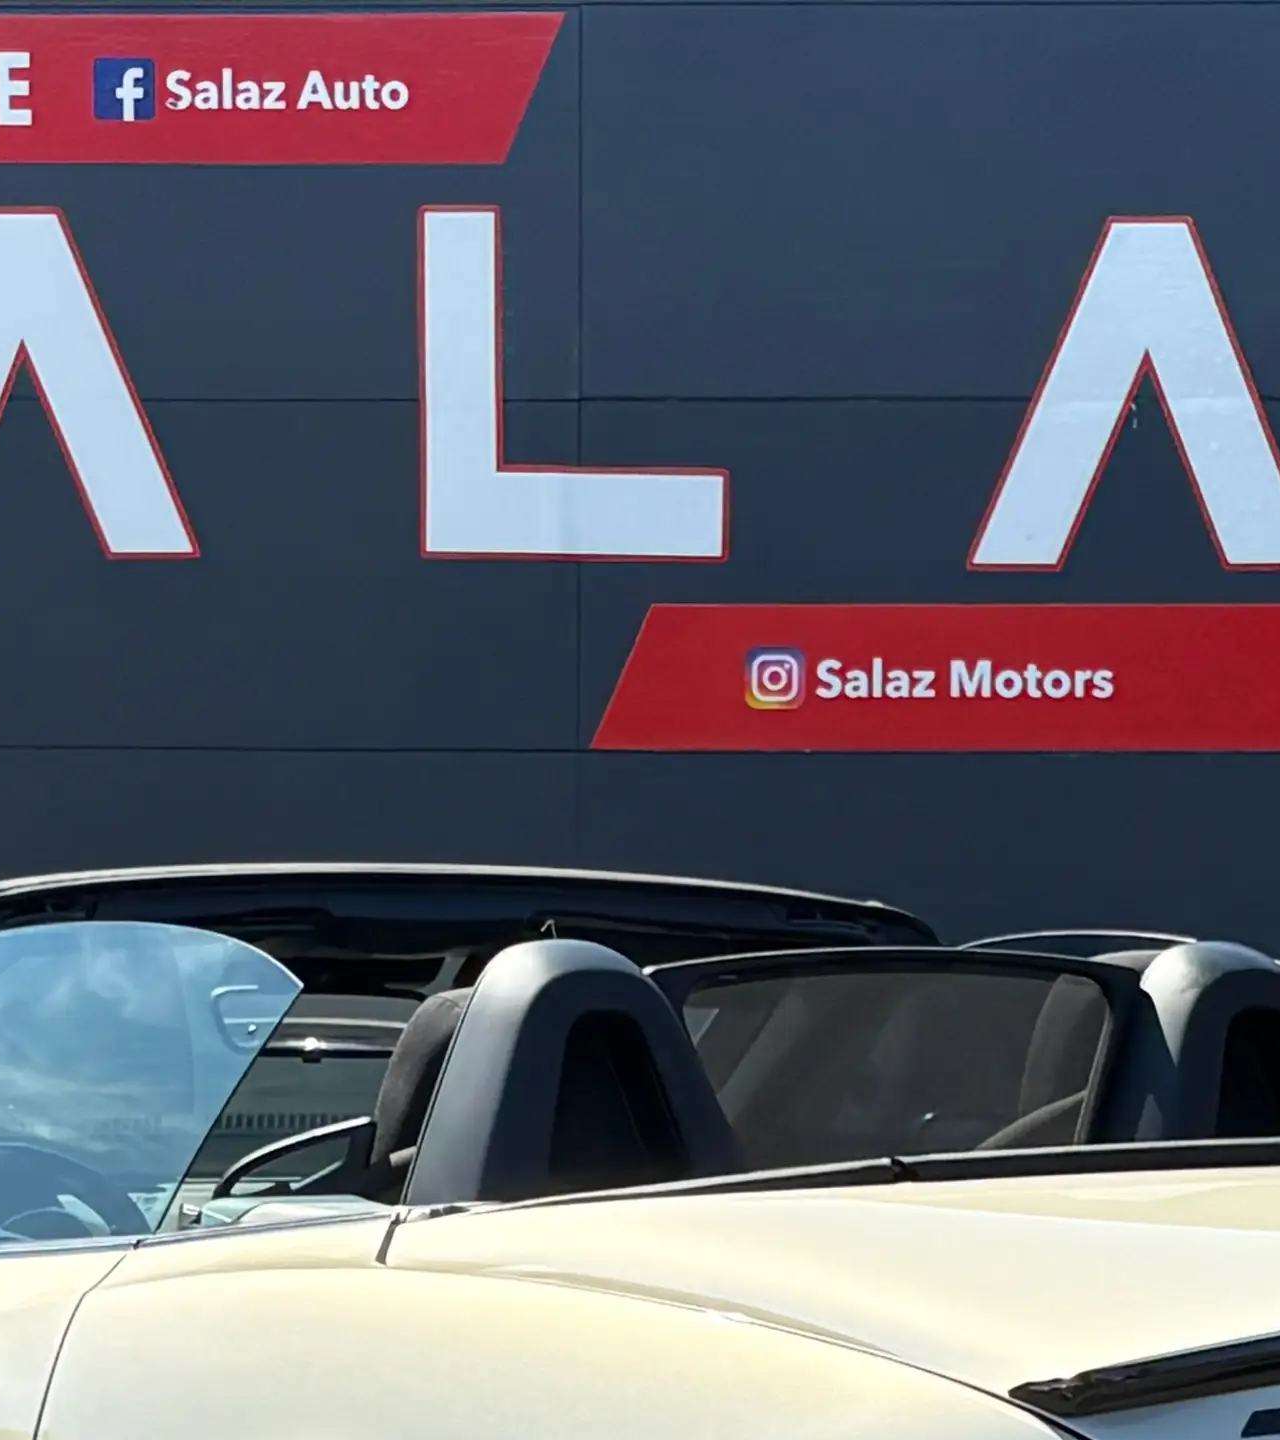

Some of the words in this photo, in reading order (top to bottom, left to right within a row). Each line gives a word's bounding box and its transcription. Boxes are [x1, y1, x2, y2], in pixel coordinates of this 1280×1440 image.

[163, 67, 287, 111] Salaz
[296, 69, 410, 111] Auto
[815, 657, 937, 699] Salaz
[950, 658, 1114, 699] Motors
